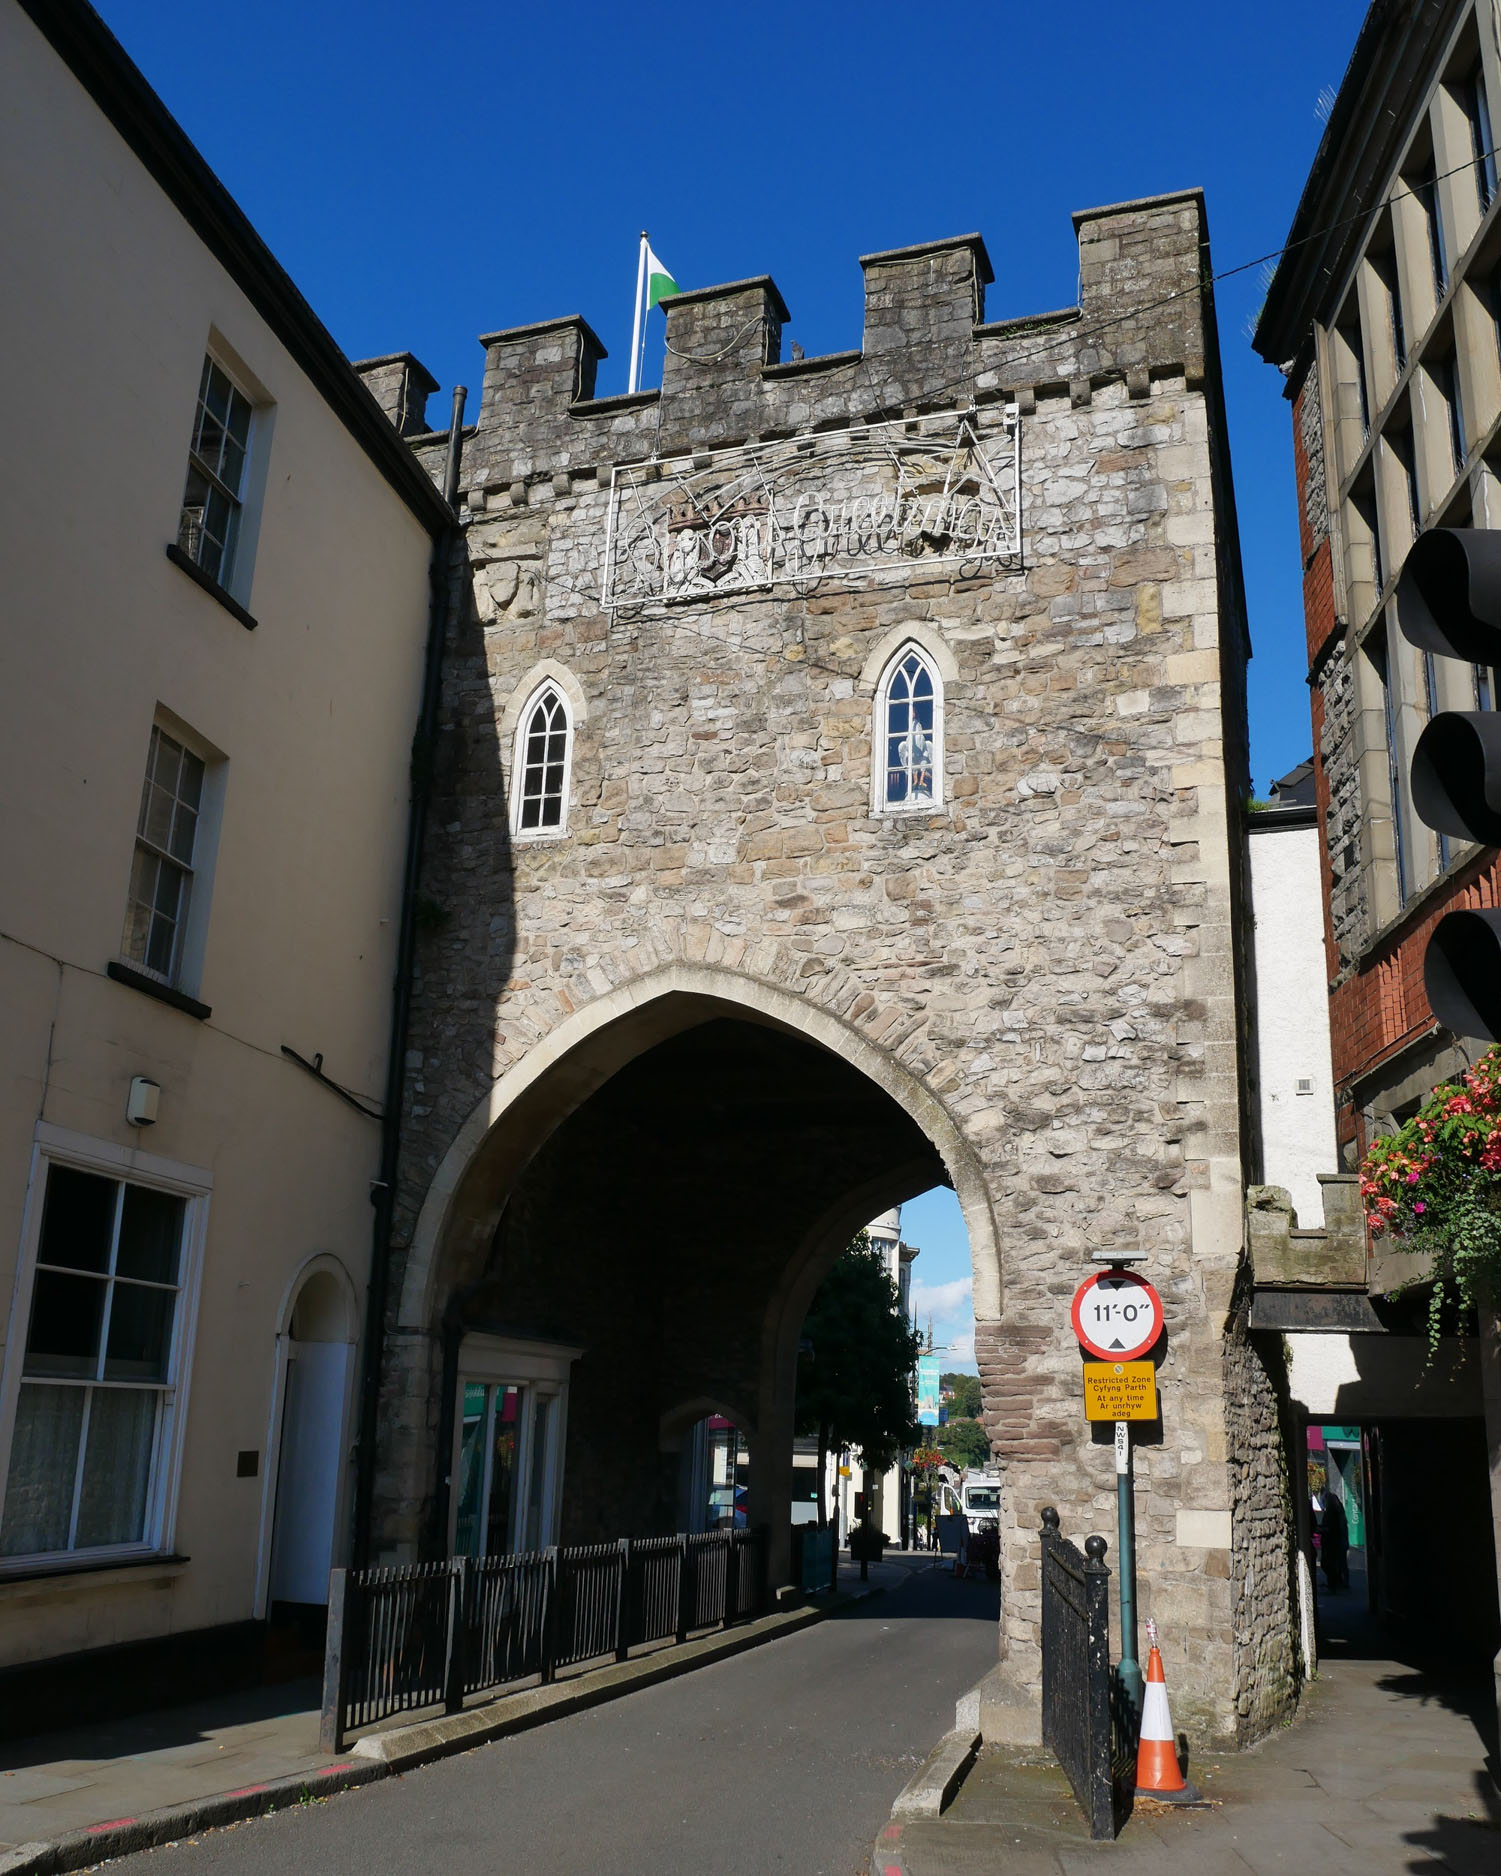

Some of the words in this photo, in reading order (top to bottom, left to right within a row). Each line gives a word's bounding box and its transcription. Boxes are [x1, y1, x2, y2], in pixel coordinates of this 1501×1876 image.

[1087, 1376, 1129, 1384] Restricted
[1131, 1375, 1151, 1383] Zone
[1093, 1384, 1121, 1392] Cyfyng
[1125, 1383, 1147, 1391] Parth
[1112, 1402, 1142, 1410] unrhyw
[1112, 1410, 1131, 1418] adeg
